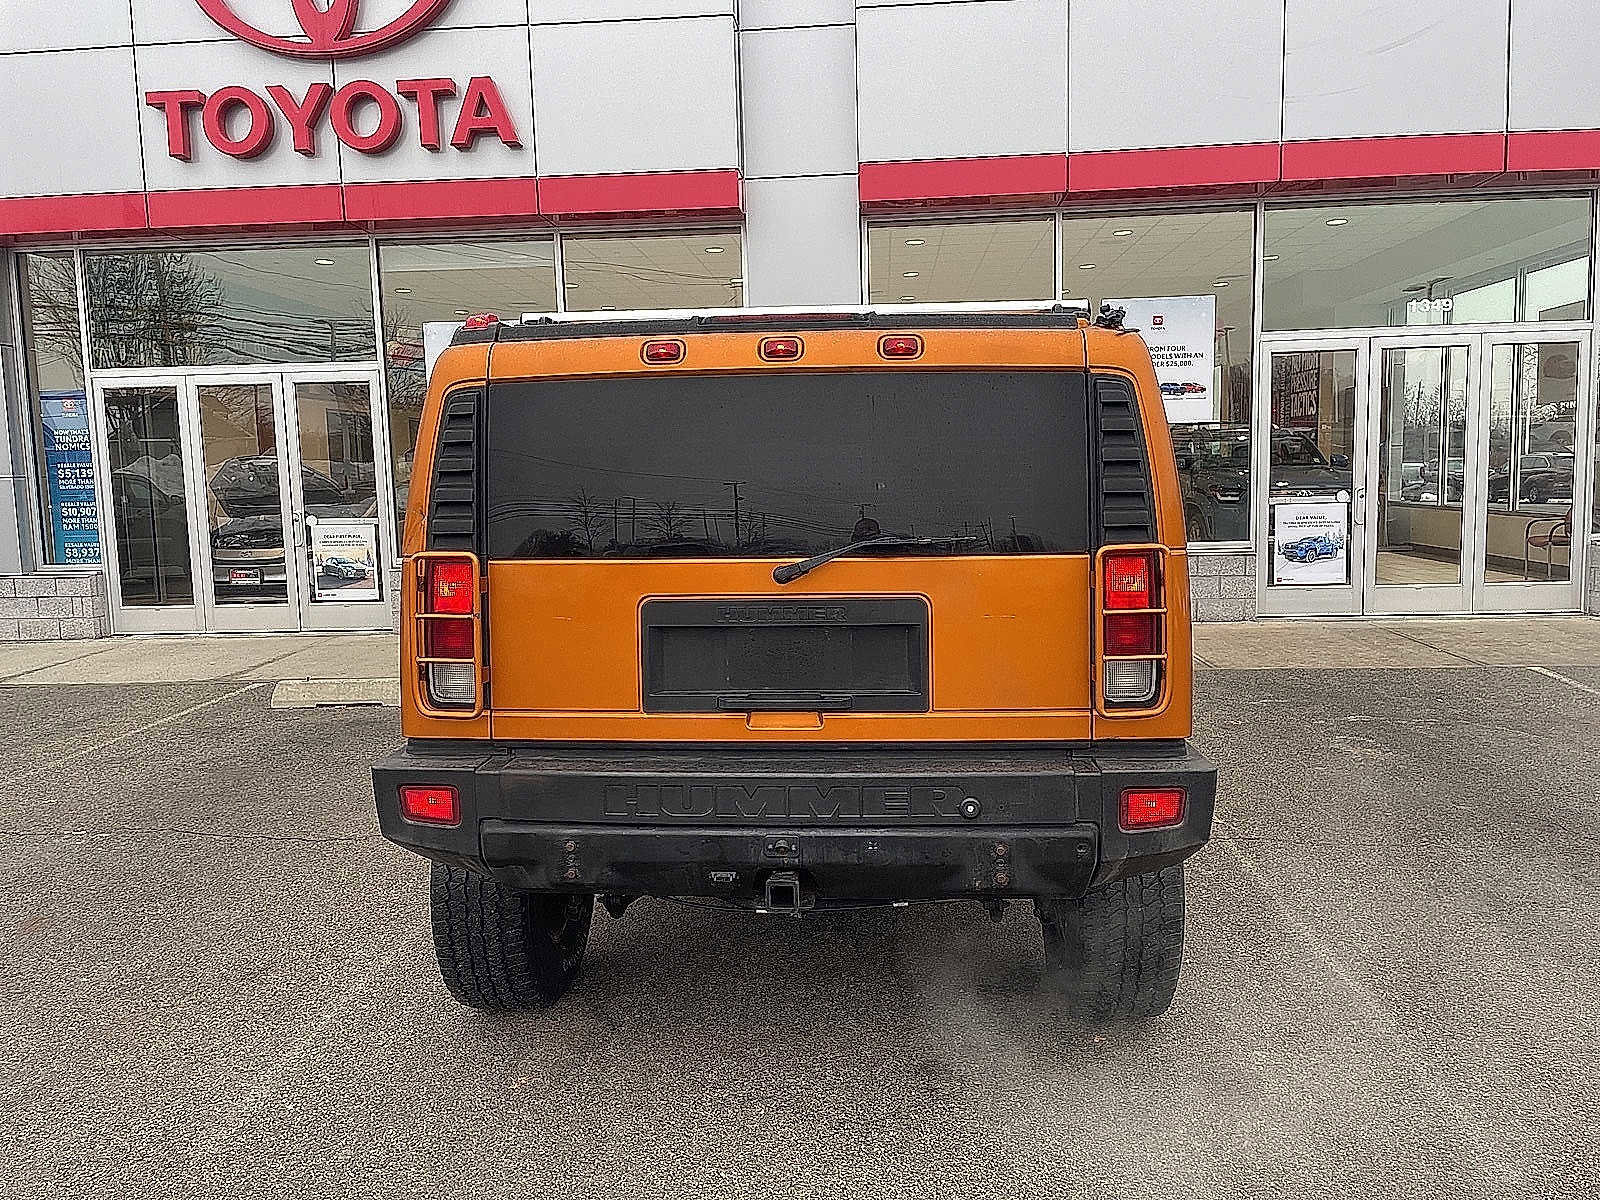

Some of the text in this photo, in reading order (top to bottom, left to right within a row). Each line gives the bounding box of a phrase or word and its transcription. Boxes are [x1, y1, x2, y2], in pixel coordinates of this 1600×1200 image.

[145, 75, 523, 163] TOYOTA
[1409, 298, 1453, 312] 1349
[1290, 391, 1318, 418] TACTICS
[54, 435, 90, 443] TUNDRA
[55, 442, 91, 451] NOMICS
[57, 468, 94, 479] $5,139
[61, 507, 97, 518] $10,907
[63, 523, 81, 531] RAM
[65, 547, 100, 558] $8,937
[717, 605, 849, 624] HUMMER
[603, 784, 965, 819] HUMMER
